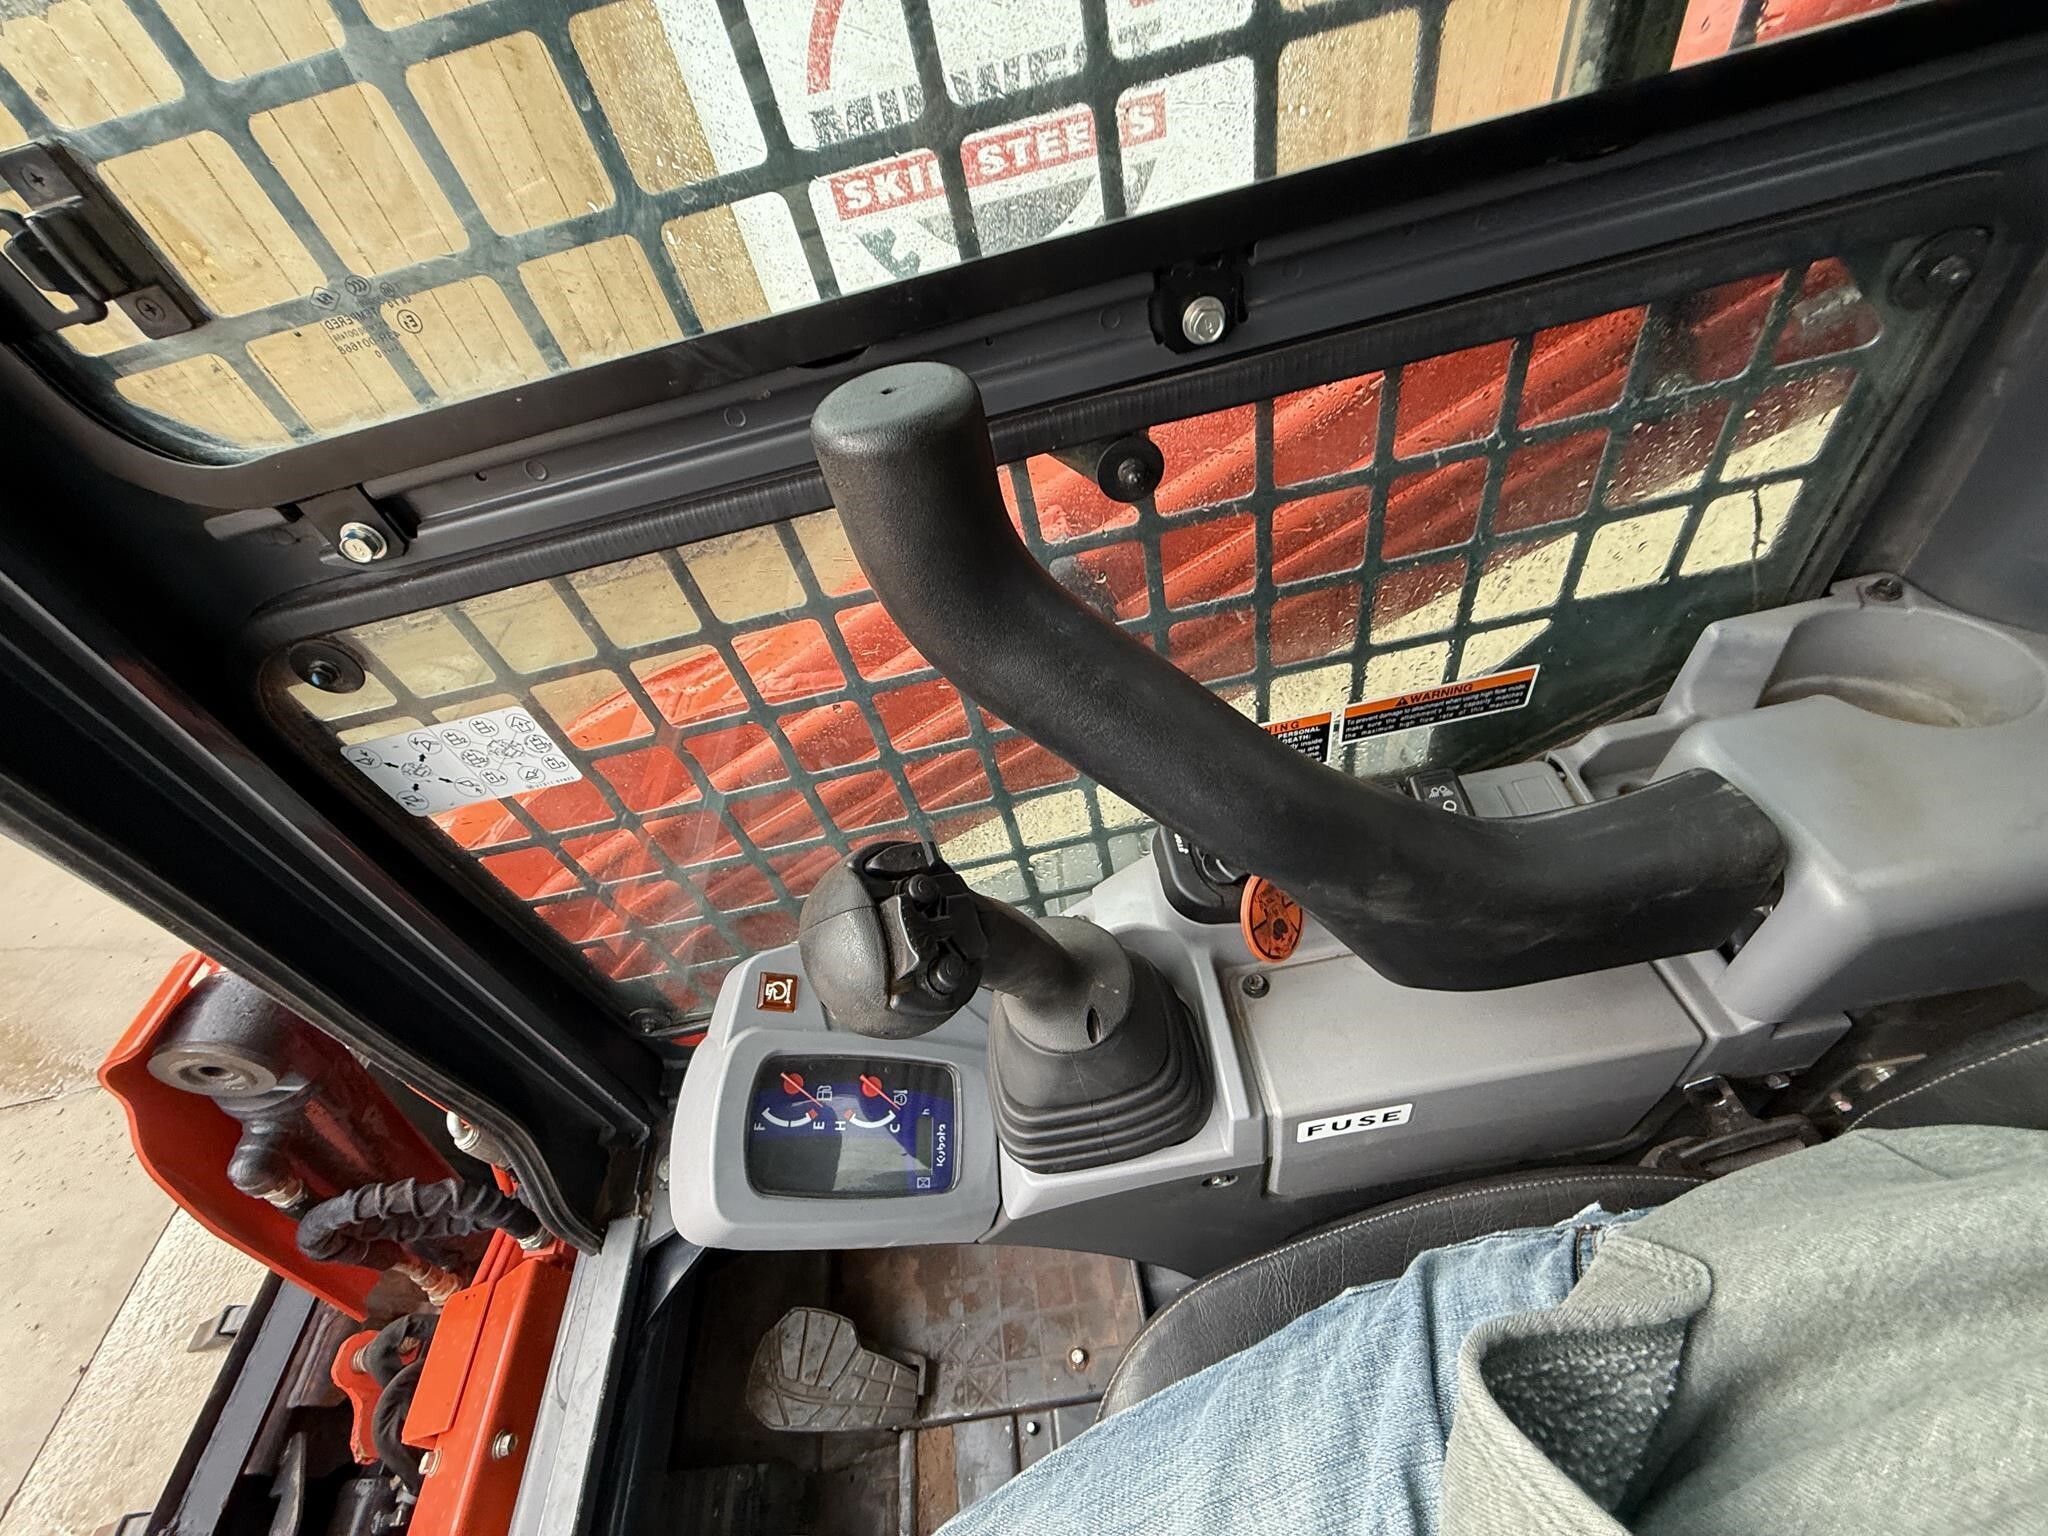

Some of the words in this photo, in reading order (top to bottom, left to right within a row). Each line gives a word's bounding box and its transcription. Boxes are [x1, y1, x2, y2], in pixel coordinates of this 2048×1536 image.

[977, 105, 1156, 175] STEES
[1410, 683, 1473, 702] WARNING
[1355, 715, 1378, 725] prevent
[1379, 710, 1403, 721] damage
[1265, 721, 1300, 733] NING
[1277, 726, 1321, 739] PERSONAL
[1346, 725, 1364, 733] make
[1367, 721, 1382, 729] sure
[753, 1122, 766, 1131] F
[813, 1121, 825, 1130] E
[835, 1121, 846, 1131] H
[890, 1124, 900, 1133] C
[1308, 1110, 1402, 1137] FUSE
[936, 1124, 946, 1167] Kubota
